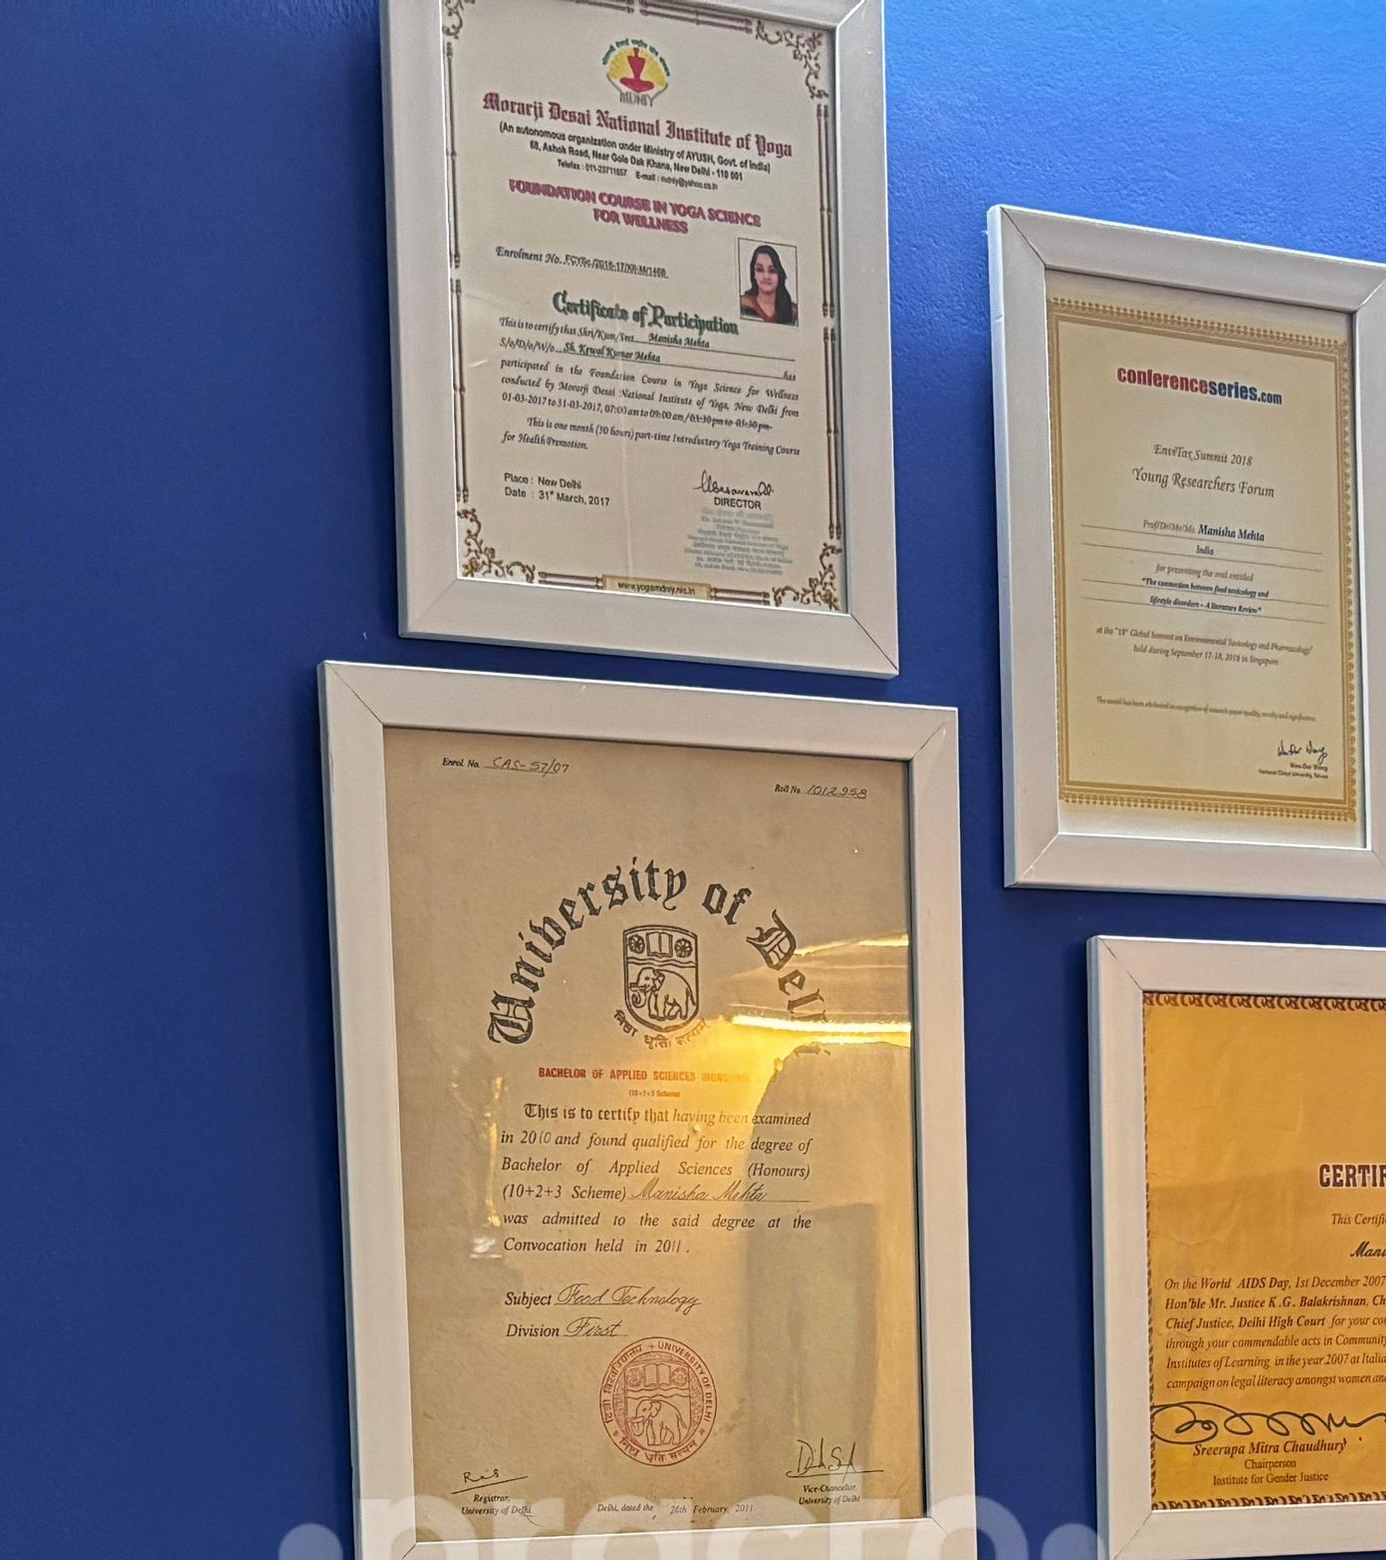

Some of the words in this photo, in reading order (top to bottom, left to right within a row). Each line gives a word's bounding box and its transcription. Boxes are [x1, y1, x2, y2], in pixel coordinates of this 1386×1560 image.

[483, 92, 544, 121] Morarji
[549, 102, 591, 126] Desai
[596, 109, 660, 136] National
[666, 120, 731, 147] Institute
[736, 134, 751, 150] of
[755, 134, 792, 159] Yoga
[509, 179, 596, 204] FOUNDATION
[598, 192, 651, 212] COURSE
[653, 200, 667, 214] IN
[669, 202, 706, 220] YOGA
[708, 208, 761, 227] SCIENCE
[593, 208, 620, 224] FOR
[622, 212, 688, 234] WELLNESS
[553, 290, 629, 322] Certificate
[633, 302, 649, 328] of
[649, 302, 741, 336] Participation
[1117, 368, 1282, 404] conferenceseries.com
[1131, 467, 1168, 488] Young
[1172, 473, 1235, 492] Researchers
[1239, 481, 1274, 498] Forum
[714, 497, 761, 510] DIRECTOR
[1198, 524, 1236, 538] Manisha
[1238, 529, 1264, 541] Mehta
[487, 856, 687, 1046] University
[702, 882, 752, 925] of
[539, 1067, 586, 1078] BACHELOR
[592, 1069, 603, 1079] OF
[610, 1070, 647, 1080] APPLIED
[654, 1071, 694, 1081] SCIENCES
[524, 1103, 558, 1123] This
[563, 1108, 576, 1119] is
[581, 1107, 593, 1120] to
[598, 1107, 640, 1125] certify
[645, 1108, 668, 1124] that
[673, 1109, 715, 1129] having
[719, 1112, 747, 1123] been
[752, 1108, 811, 1130] examined
[501, 1131, 513, 1143] in
[520, 1130, 551, 1144] 2010
[555, 1132, 581, 1145] and
[586, 1131, 627, 1149] found
[632, 1134, 690, 1151] qualified
[694, 1133, 717, 1152] for
[726, 1136, 745, 1149] the
[750, 1134, 793, 1154] degree
[798, 1138, 813, 1155] of
[501, 1155, 563, 1173] Bachelor
[576, 1159, 592, 1176] of
[608, 1159, 661, 1176] Applied
[678, 1161, 732, 1176] Sciences
[748, 1163, 810, 1180] (Honours)
[503, 1184, 562, 1200] (10+2+3
[571, 1185, 626, 1202] Scheme)
[502, 1214, 528, 1230] was
[542, 1211, 600, 1230] admitted
[613, 1216, 625, 1226] to
[640, 1213, 659, 1226] the
[672, 1214, 699, 1227] said
[712, 1214, 755, 1231] degree
[768, 1218, 780, 1228] at
[793, 1215, 811, 1228] the
[1332, 1214, 1351, 1224] This
[504, 1237, 586, 1251] Convocation
[595, 1238, 624, 1252] held
[635, 1240, 647, 1252] in
[505, 1292, 552, 1308] Subject
[610, 1284, 702, 1315] Technology
[506, 1324, 559, 1337] Division
[658, 1342, 704, 1375] UNIVERSITY
[703, 1376, 711, 1390] OF
[705, 1392, 713, 1423] DELHI
